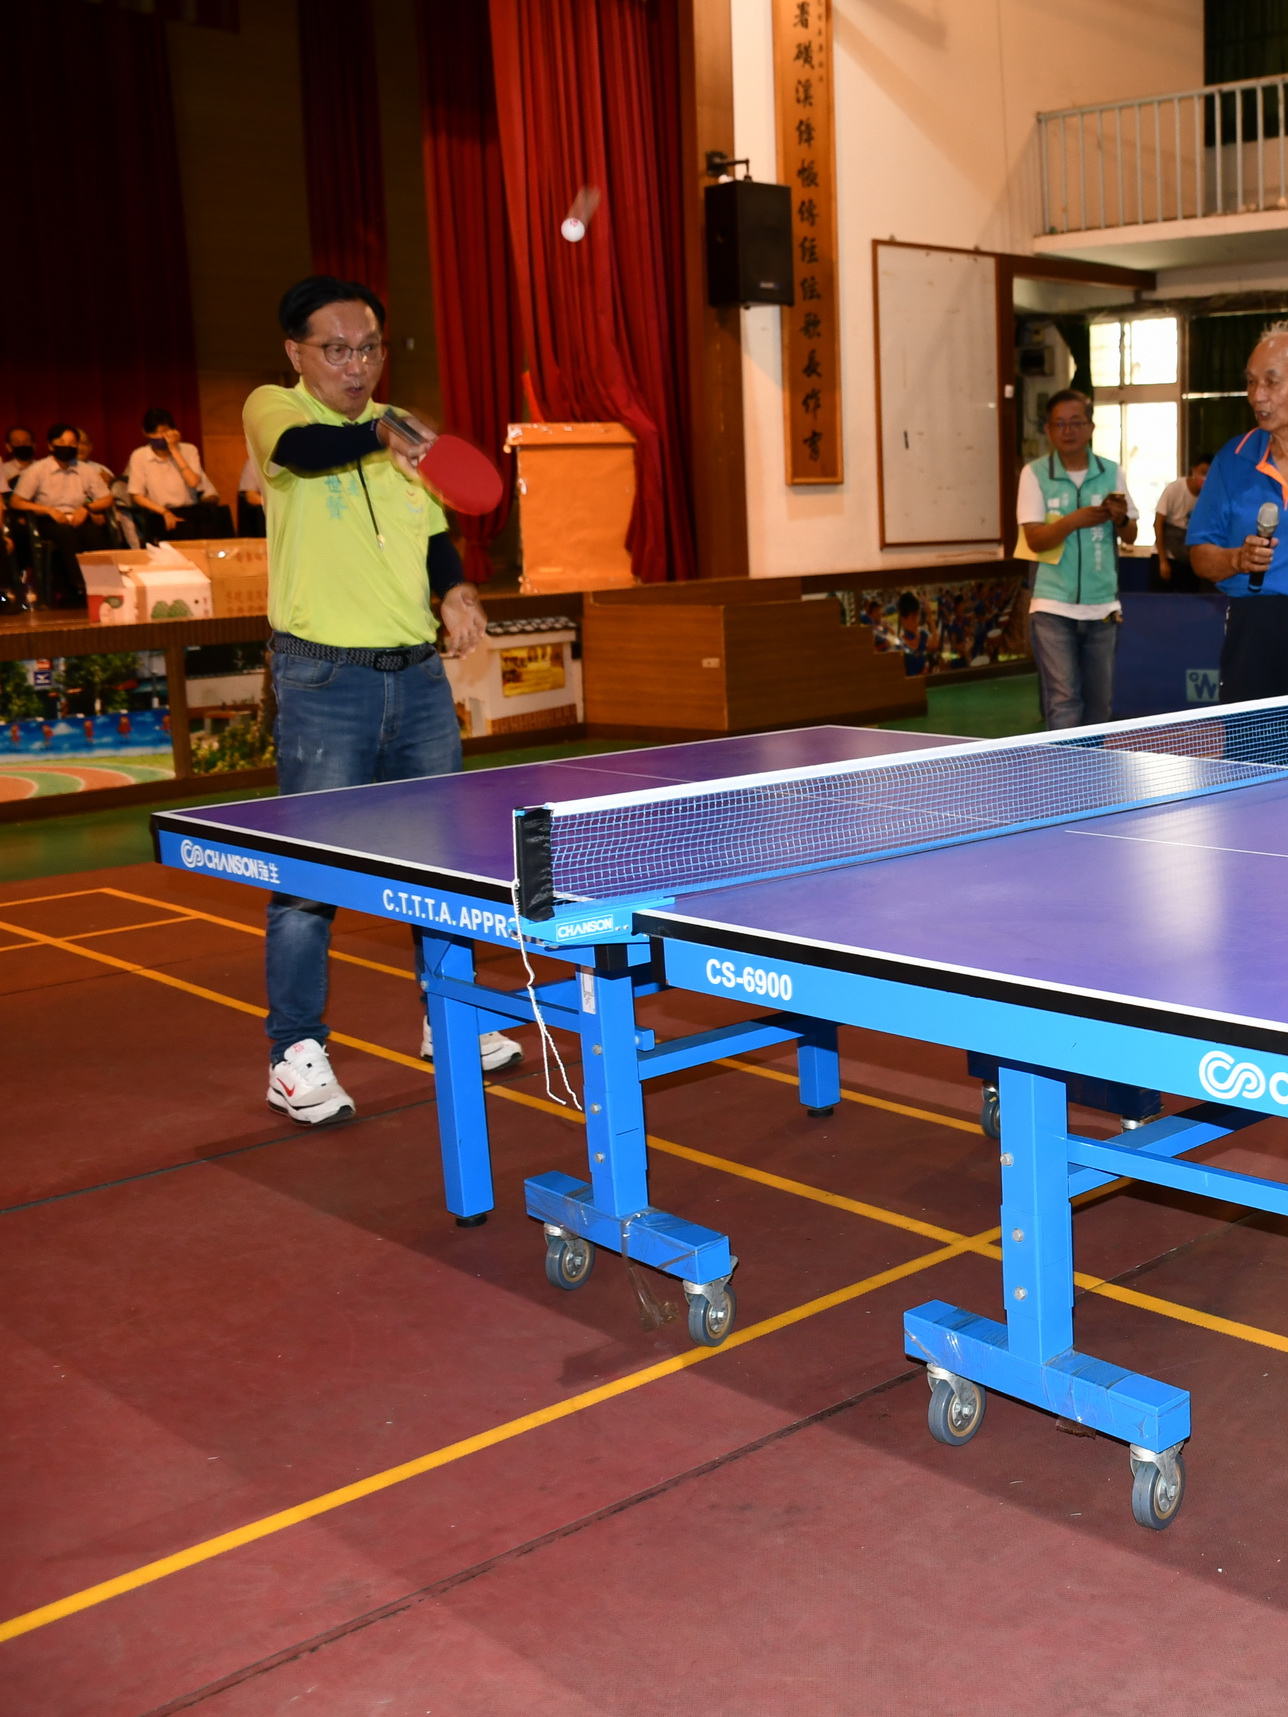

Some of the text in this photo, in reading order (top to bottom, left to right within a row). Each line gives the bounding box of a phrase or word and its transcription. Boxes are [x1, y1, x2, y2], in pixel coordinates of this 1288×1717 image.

[204, 848, 259, 879] CHANSON
[382, 888, 456, 926] C.T.T.T.A.
[557, 917, 613, 938] CHANSON
[706, 958, 793, 1001] CS-6900
